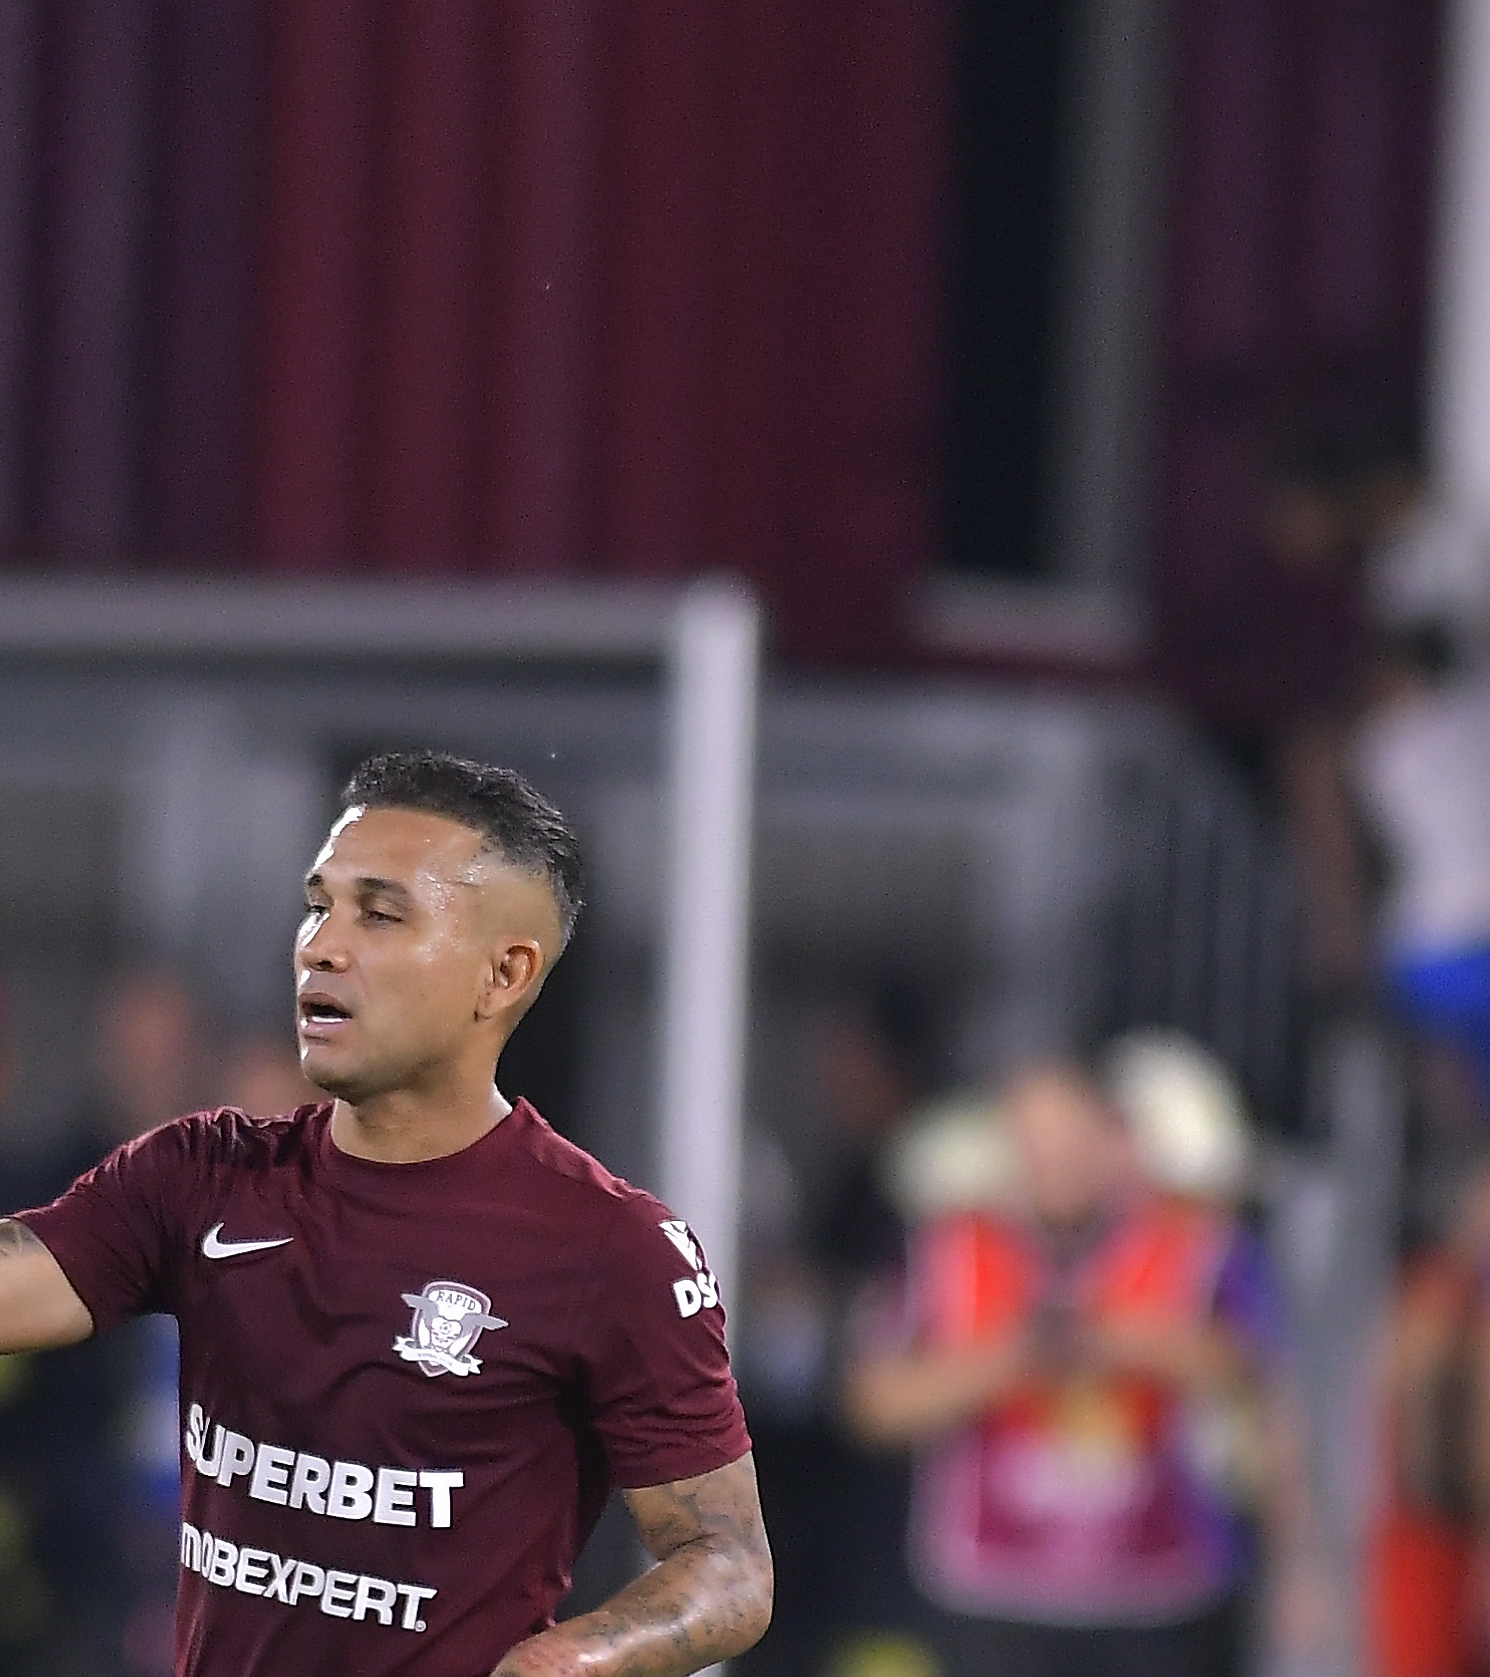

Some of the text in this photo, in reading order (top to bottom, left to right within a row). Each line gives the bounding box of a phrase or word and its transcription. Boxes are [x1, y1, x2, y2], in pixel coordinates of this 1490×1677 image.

[436, 1291, 476, 1311] RAPID
[672, 1271, 719, 1318] DS
[186, 1403, 464, 1528] SUPERBET
